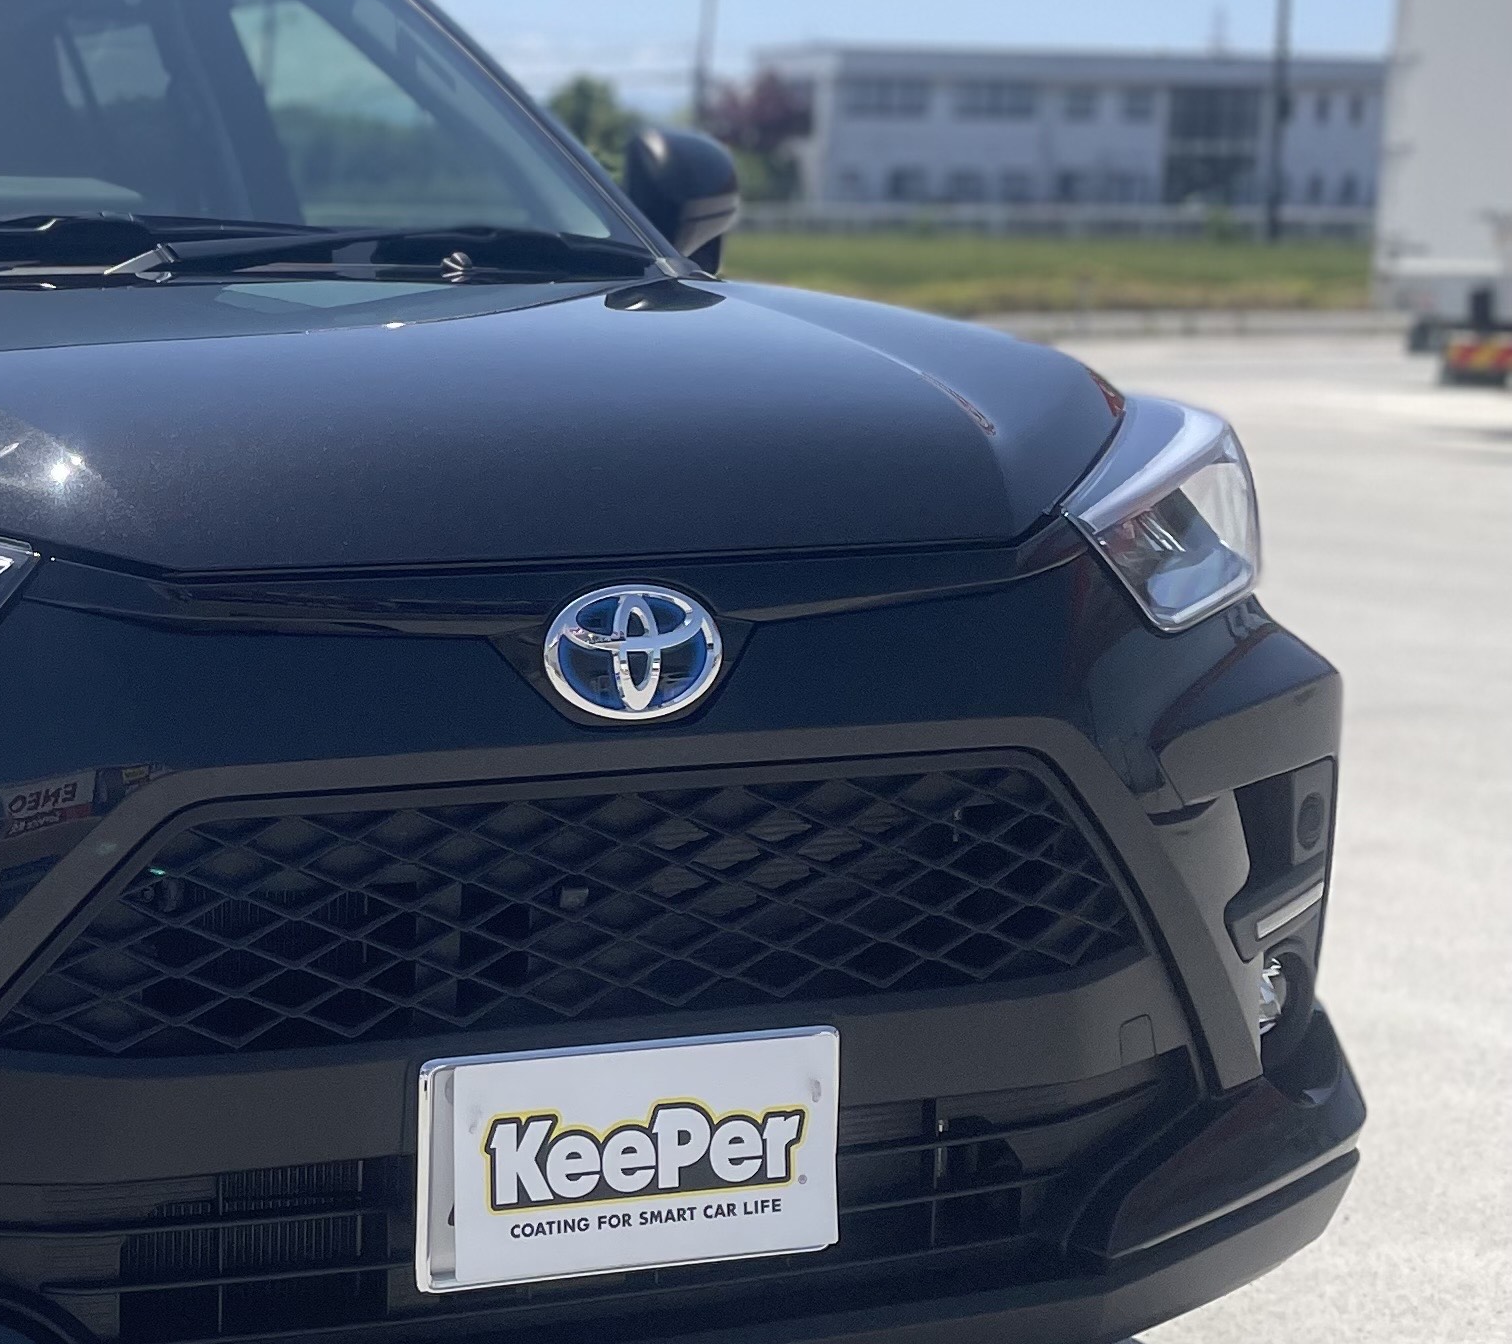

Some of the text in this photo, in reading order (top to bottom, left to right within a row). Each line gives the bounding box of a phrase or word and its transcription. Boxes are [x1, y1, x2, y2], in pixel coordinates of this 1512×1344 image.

[485, 1102, 806, 1212] KeePer
[510, 1198, 782, 1239] COATING FOR SMART CAR LIFE
